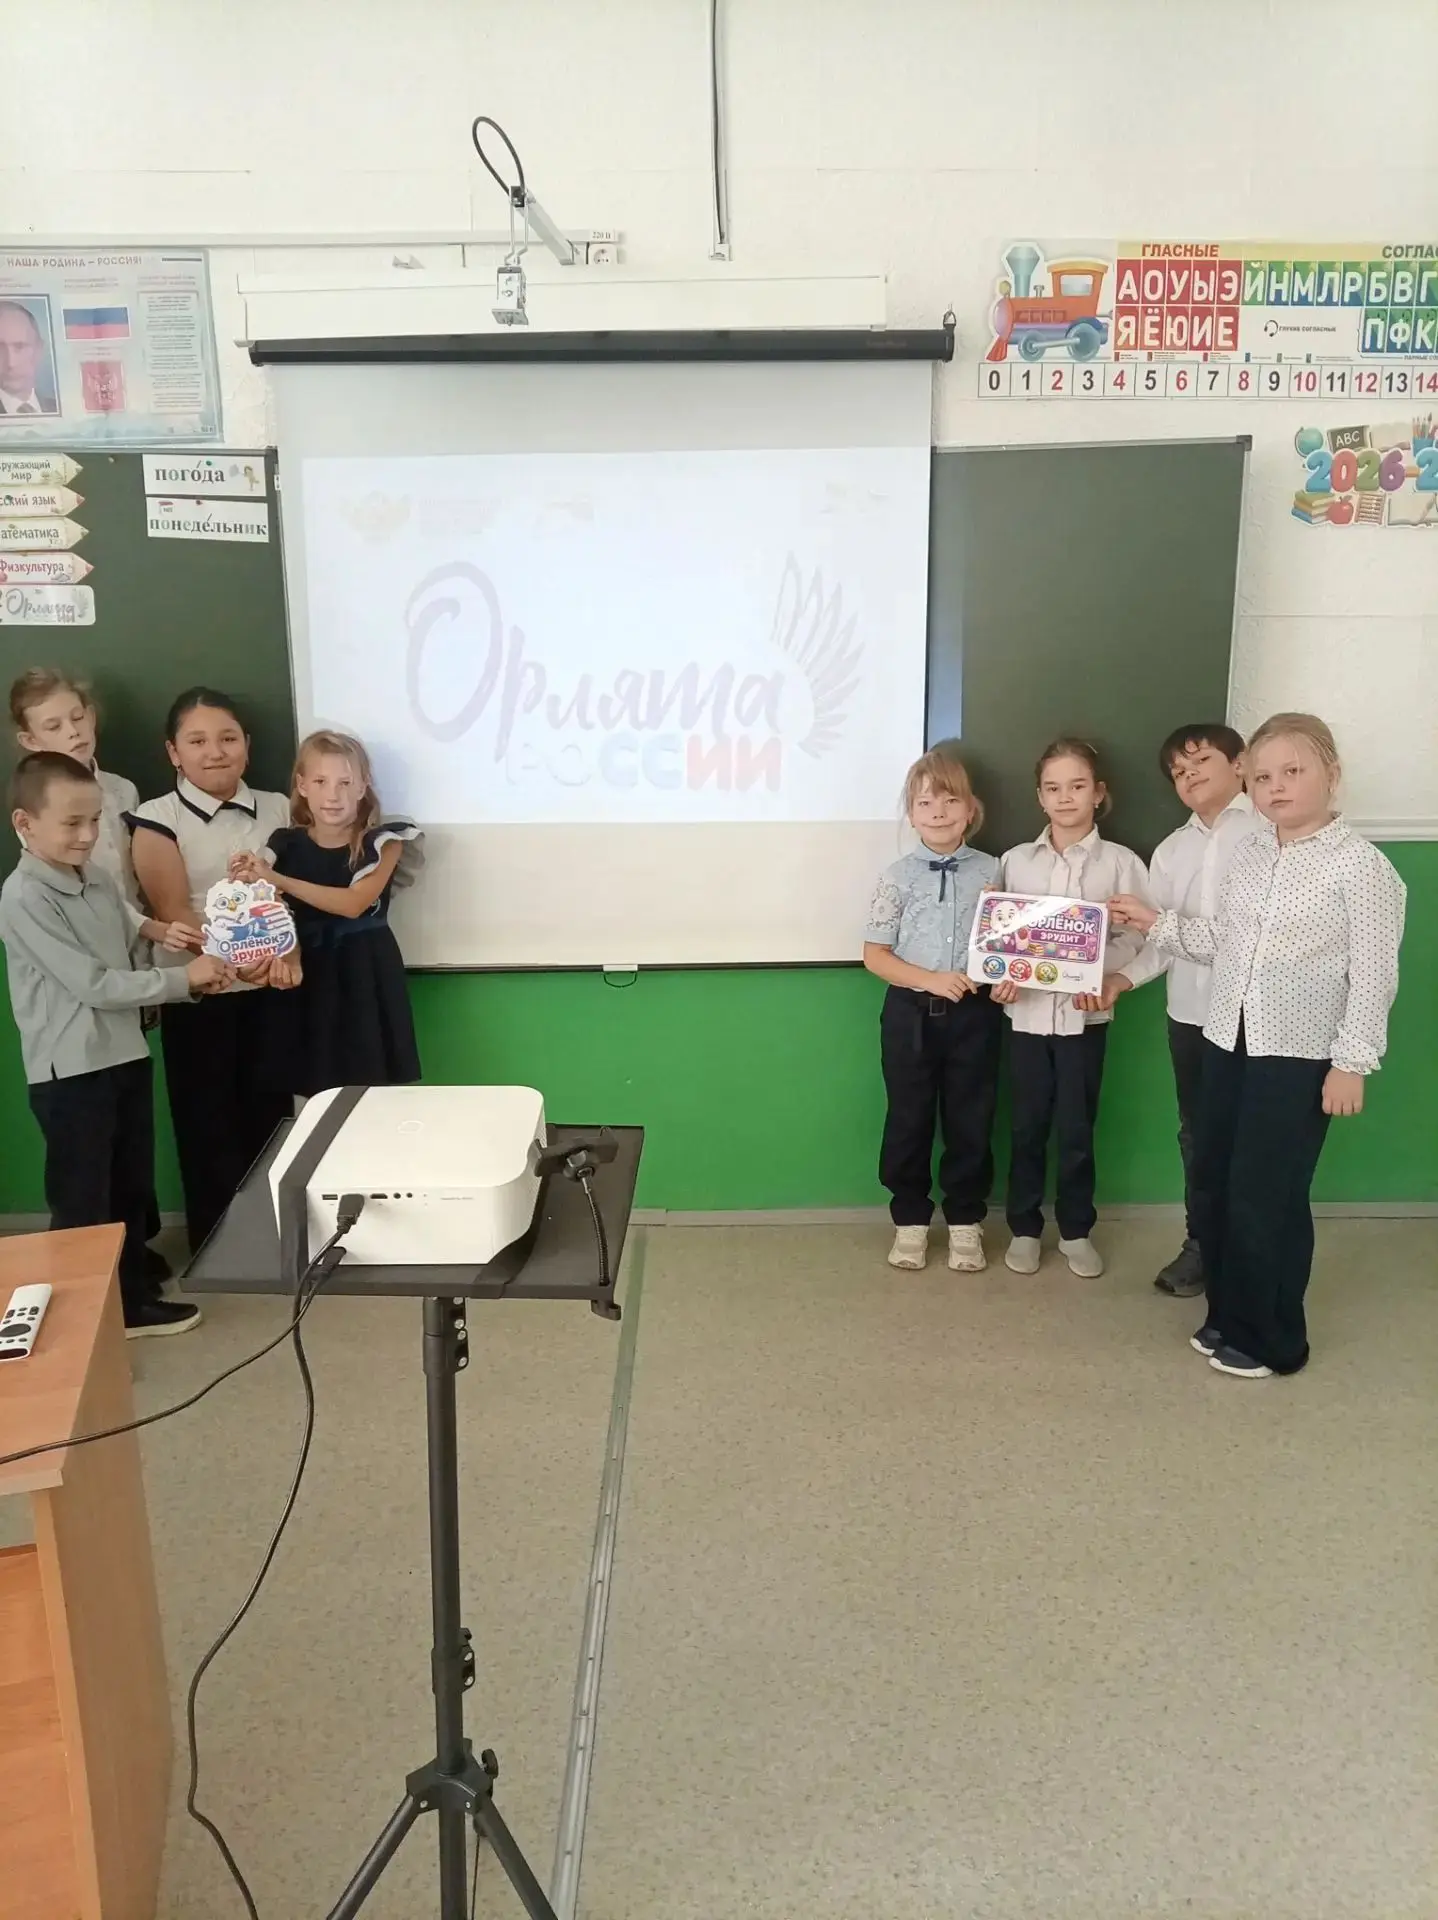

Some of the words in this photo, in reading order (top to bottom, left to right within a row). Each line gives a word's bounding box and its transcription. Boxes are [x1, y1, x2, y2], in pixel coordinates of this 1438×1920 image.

[1141, 244, 1220, 257] ГЛАСНЫЕ
[1381, 244, 1438, 258] СОГЛА
[7, 257, 39, 267] НАША
[42, 257, 86, 267] РОДИНА
[988, 370, 1000, 390] 0
[1021, 370, 1031, 390] 1
[1051, 370, 1063, 390] 2
[1082, 370, 1094, 390] 3
[1112, 370, 1126, 390] 4
[1144, 370, 1157, 390] 5
[1175, 370, 1188, 391] 6
[1207, 370, 1219, 391] 7
[1238, 370, 1249, 391] 8
[1268, 371, 1281, 391] 9
[1293, 371, 1317, 392] 10
[1326, 371, 1346, 392] 11
[1354, 372, 1377, 392] 12
[1385, 372, 1408, 393] 13
[1415, 372, 1438, 393] 14
[1336, 431, 1360, 447] ABC
[0, 459, 51, 472] ружающий
[11, 472, 32, 483] мир
[32, 495, 56, 505] язык
[0, 558, 64, 576] Физкультура
[403, 560, 786, 764] Орлята
[1040, 932, 1080, 943] ЭРУДИТ
[231, 946, 277, 962] эрудит
